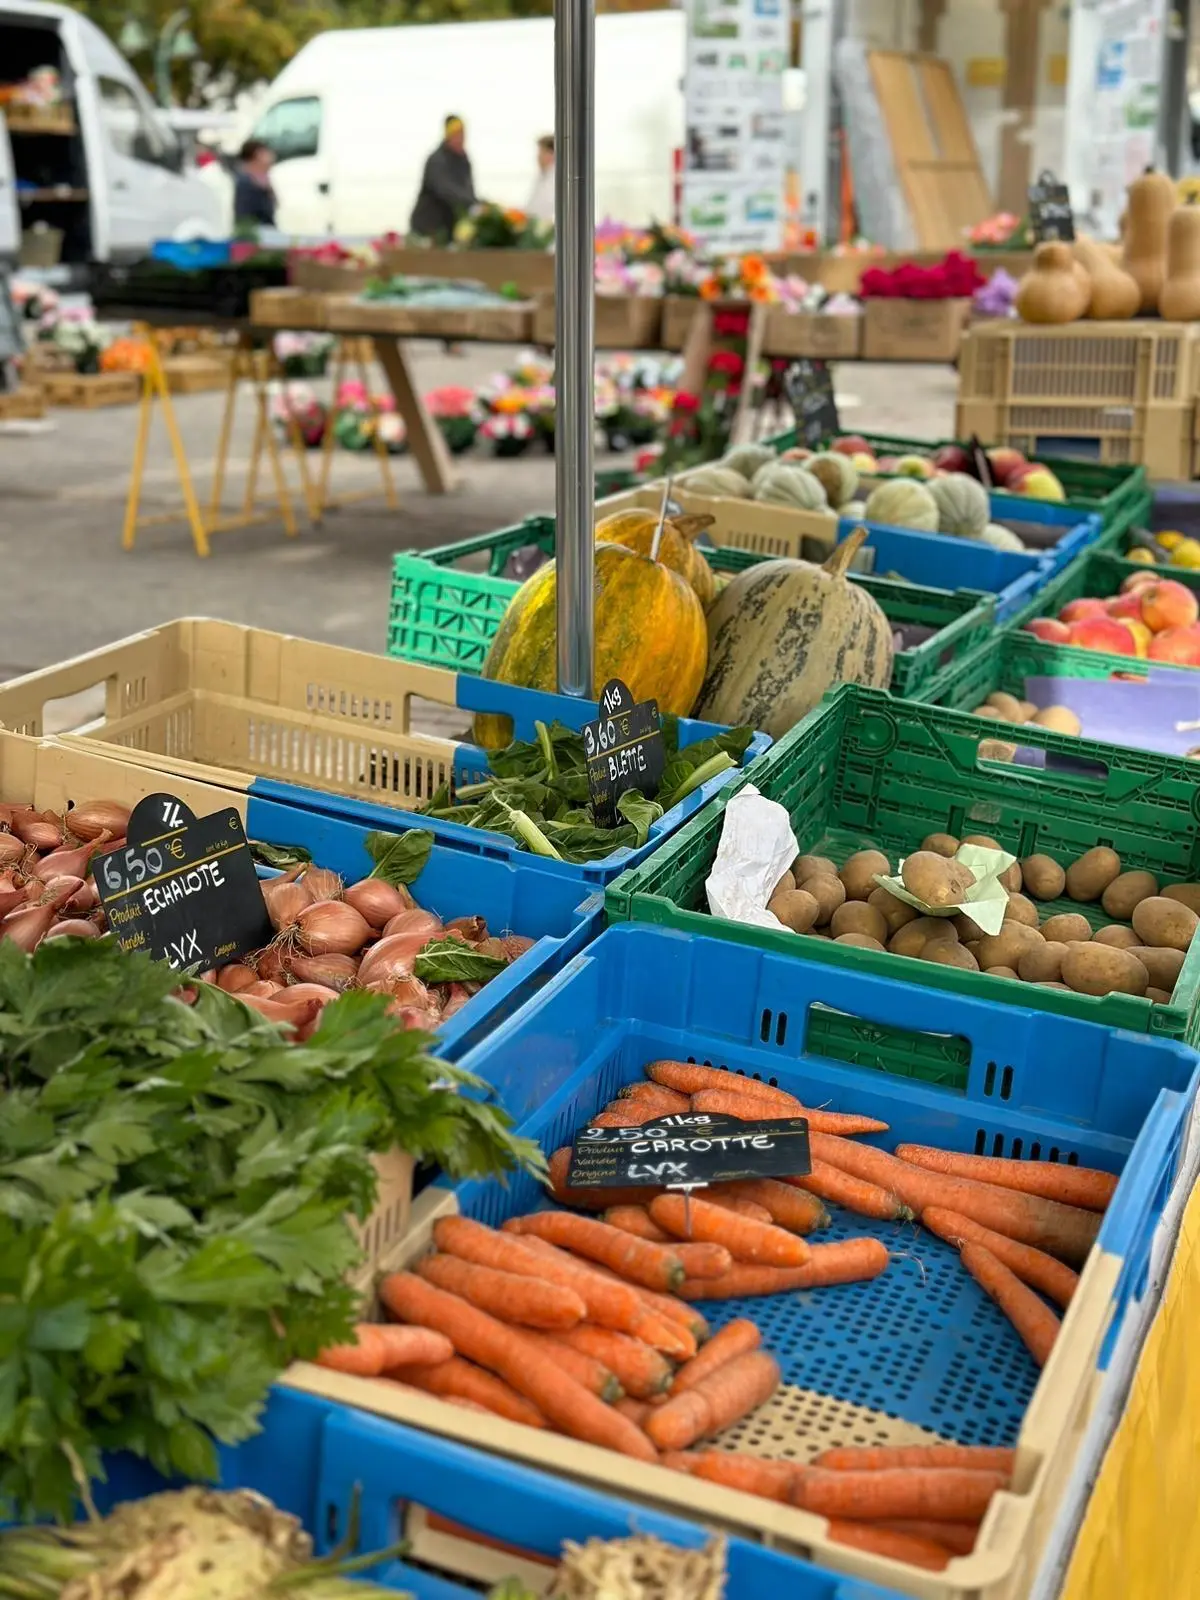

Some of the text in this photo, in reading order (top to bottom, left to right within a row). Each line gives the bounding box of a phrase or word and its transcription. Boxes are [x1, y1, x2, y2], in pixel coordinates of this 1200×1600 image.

[603, 686, 622, 714] 1kg
[584, 718, 631, 757] 3,60 €
[608, 744, 647, 781] BLETTE
[228, 817, 239, 830] €
[103, 847, 163, 893] 6,50
[109, 860, 225, 927] Produit ECHALOTE
[660, 1115, 711, 1126] 1kg
[580, 1127, 668, 1143] 2,50
[631, 1135, 775, 1153] CAROTTE
[627, 1162, 688, 1178] LVX
